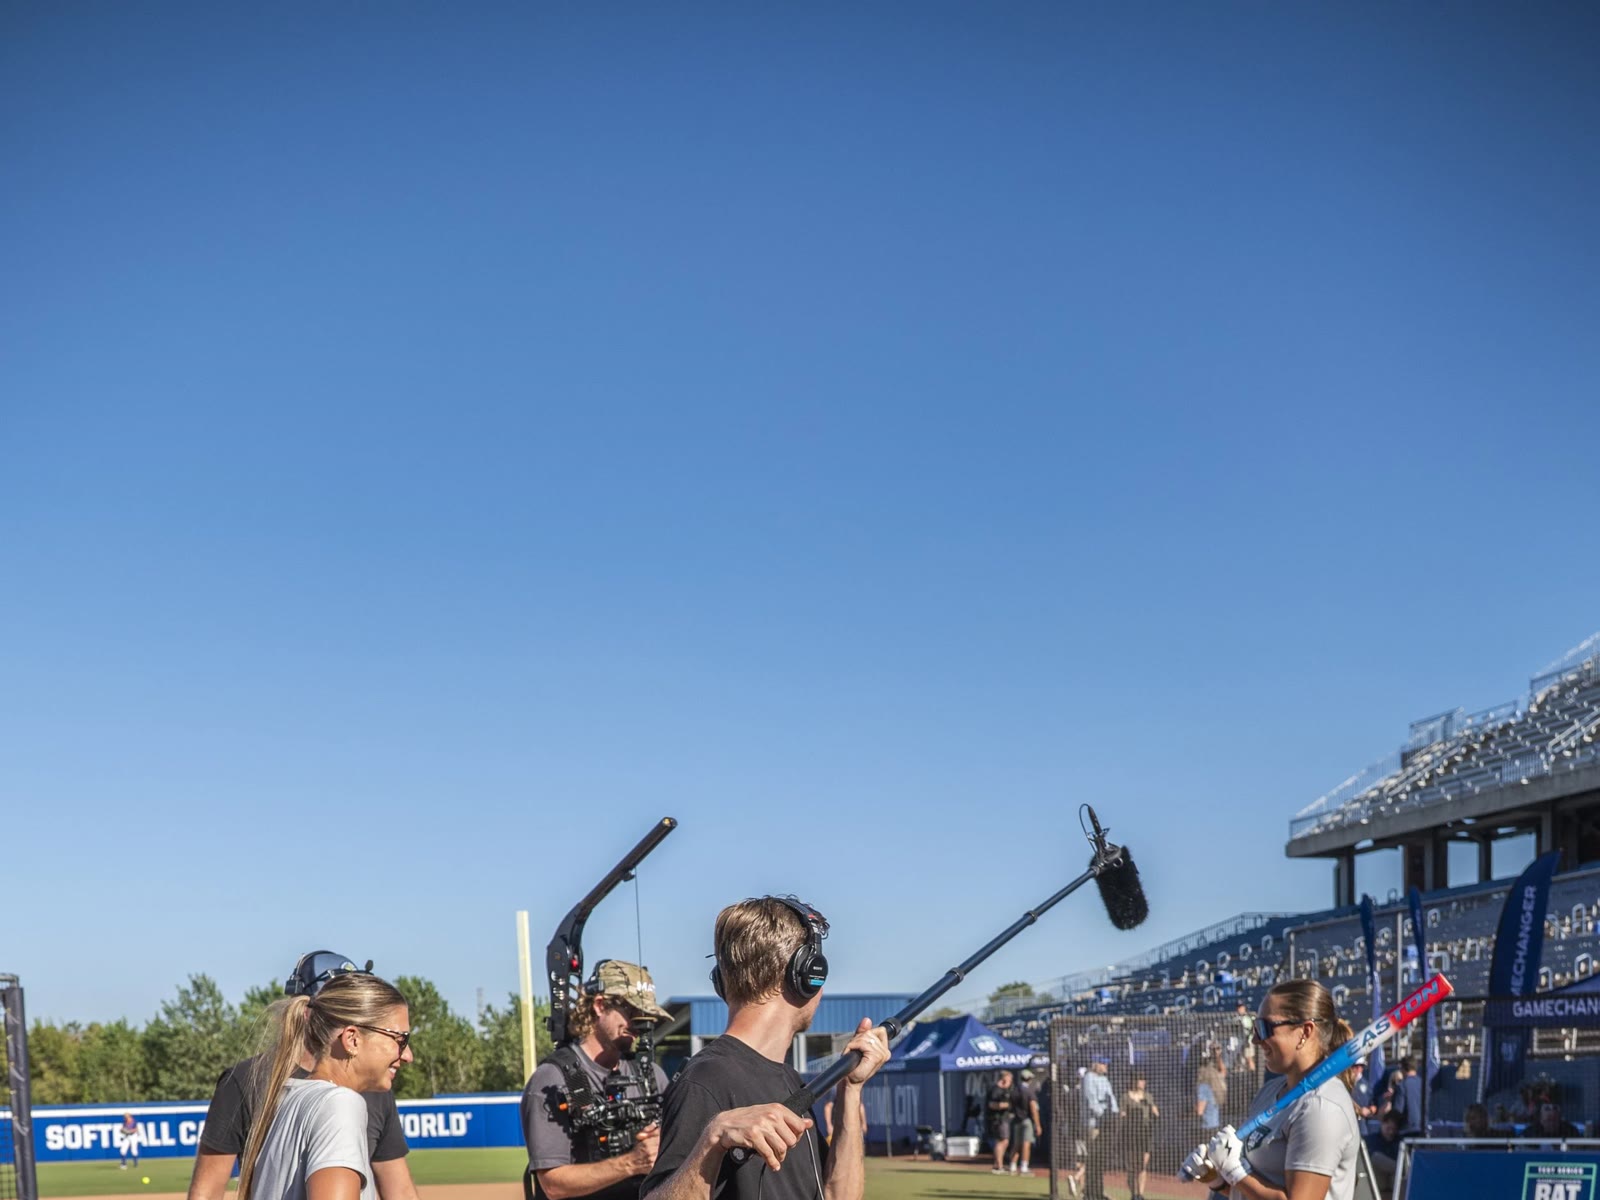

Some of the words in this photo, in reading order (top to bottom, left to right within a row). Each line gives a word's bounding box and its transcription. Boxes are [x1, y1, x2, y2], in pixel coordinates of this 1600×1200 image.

[1345, 980, 1440, 1056] EASTON
[1513, 997, 1600, 1018] GAMECHAN
[400, 1112, 468, 1138] ORLD
